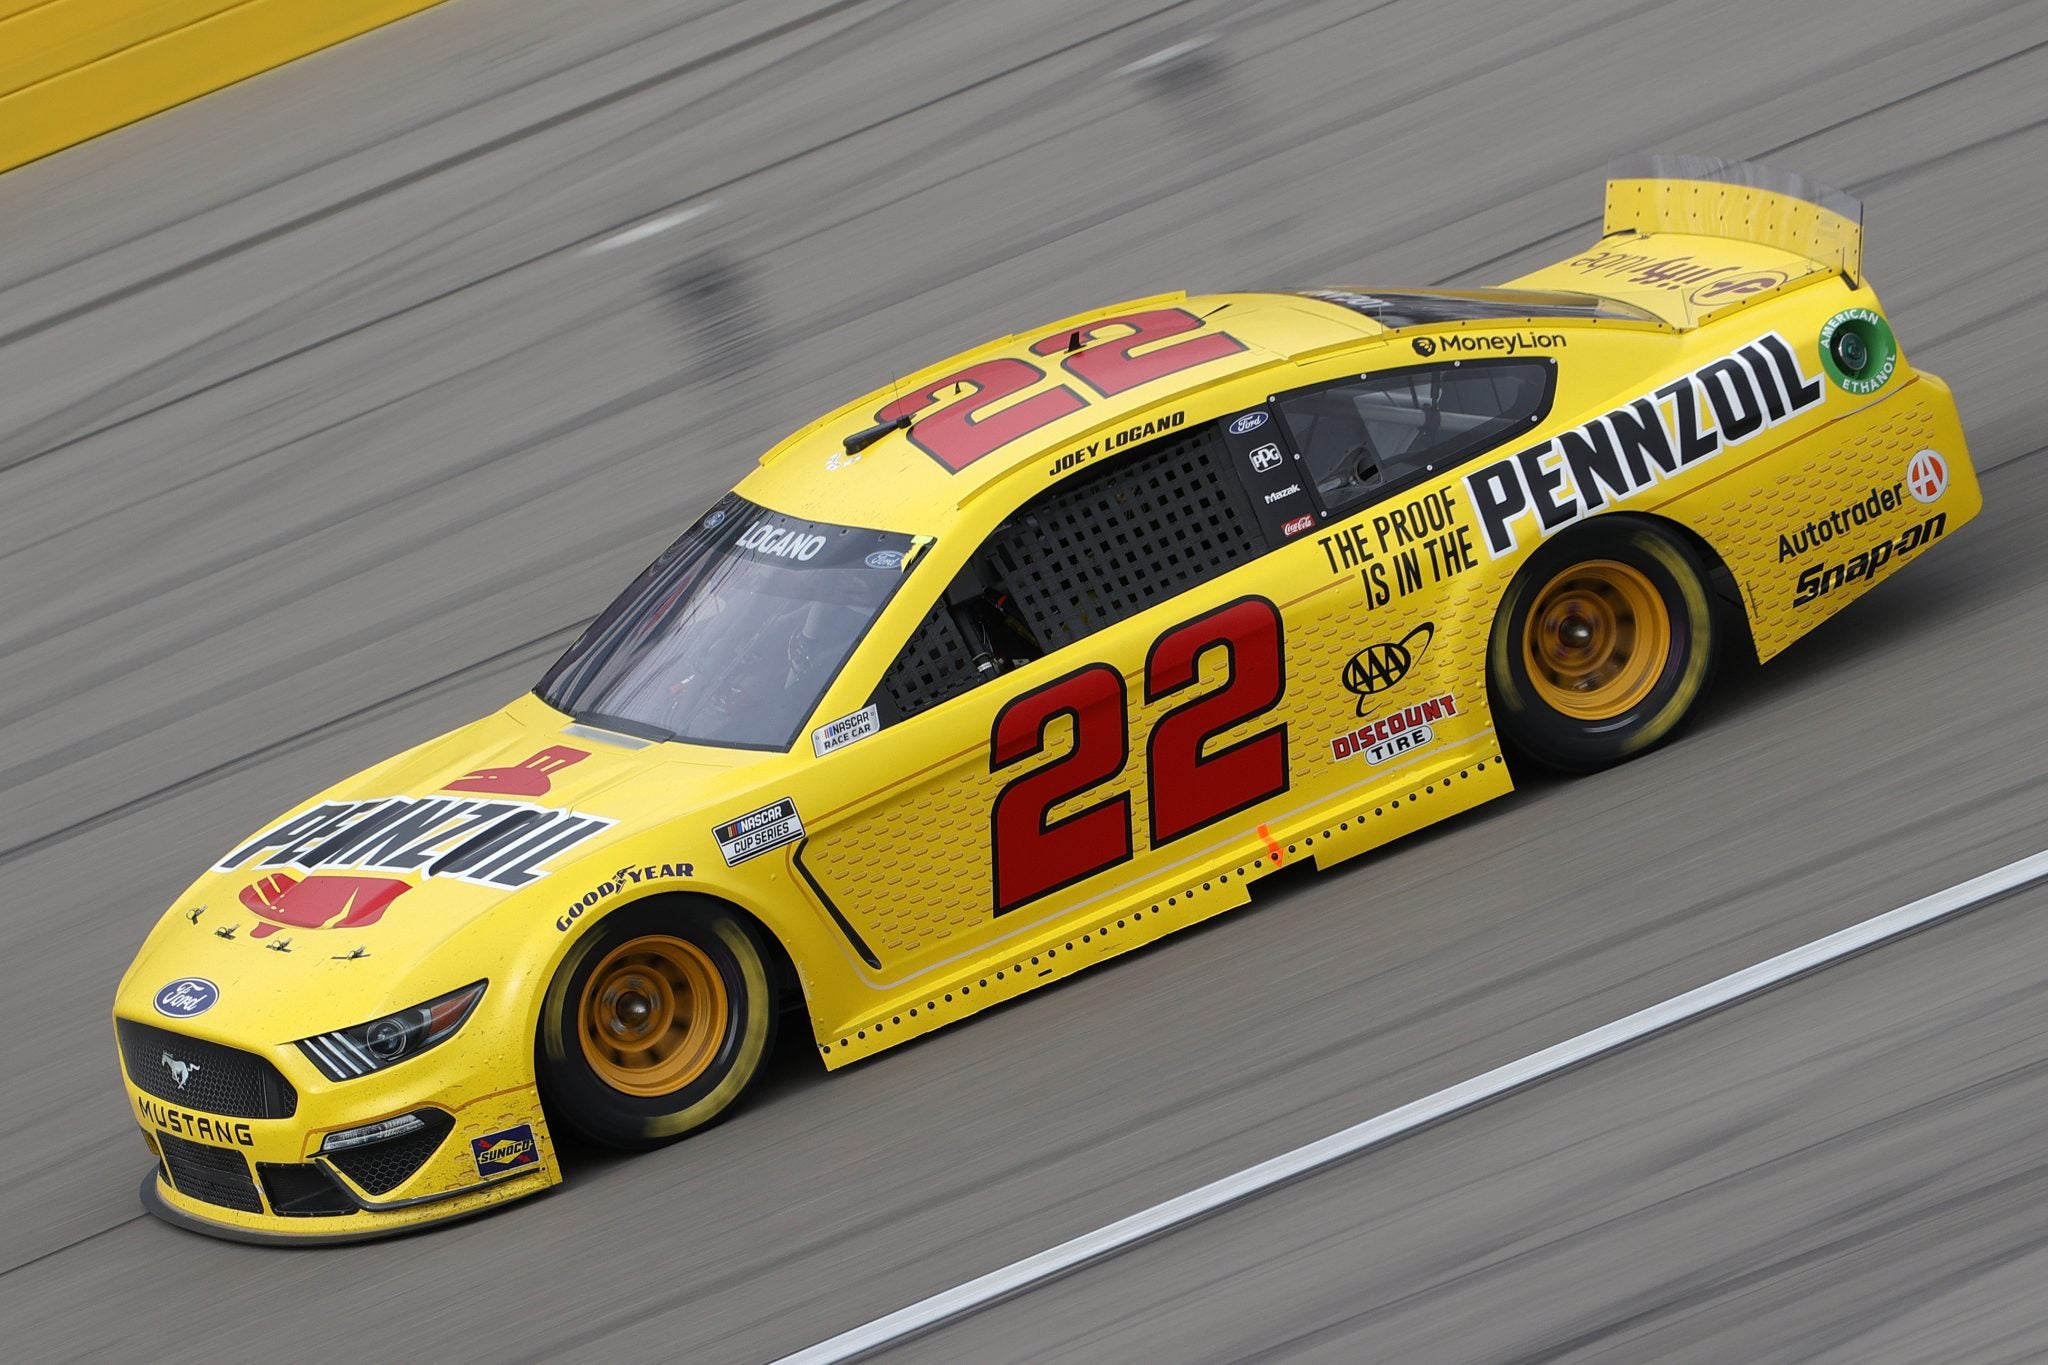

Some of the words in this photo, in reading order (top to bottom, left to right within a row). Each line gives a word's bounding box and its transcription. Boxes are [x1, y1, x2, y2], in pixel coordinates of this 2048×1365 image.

[1439, 331, 1567, 355] MoneyLion
[1819, 308, 1880, 349] AMERICAN
[874, 307, 1250, 475] 22
[1842, 354, 1896, 393] ETHANOL
[1049, 441, 1101, 477] JOEY
[1104, 410, 1186, 453] LOGANO
[1251, 447, 1281, 469] PPG
[1464, 332, 1824, 559] PENNZOIL
[1263, 483, 1302, 505] Mazak
[735, 520, 827, 561] LOGANO
[1317, 524, 1374, 574] THE
[1372, 485, 1457, 553] PROOF
[1778, 482, 1903, 564] Autotrader
[1361, 561, 1391, 611] IS
[1393, 547, 1423, 598] IN
[1423, 524, 1478, 583] THE
[1792, 511, 1947, 609] Snap-on
[1346, 643, 1410, 694] AAA
[824, 733, 850, 750] RACE
[851, 722, 872, 743] CAR
[832, 710, 870, 735] NASCAR
[1330, 695, 1457, 760] DISCOUNT
[989, 594, 1290, 919] 22
[1370, 729, 1426, 762] TIRE
[733, 835, 754, 854] CUP
[754, 821, 790, 846] SERIES
[740, 805, 783, 831] NASCAR
[214, 797, 618, 890] PENNZOIL
[556, 862, 694, 932] GOODYEAR
[161, 981, 208, 1012] Ford
[138, 1096, 255, 1146] MUSTANG
[480, 1140, 533, 1163] SUNOCO
